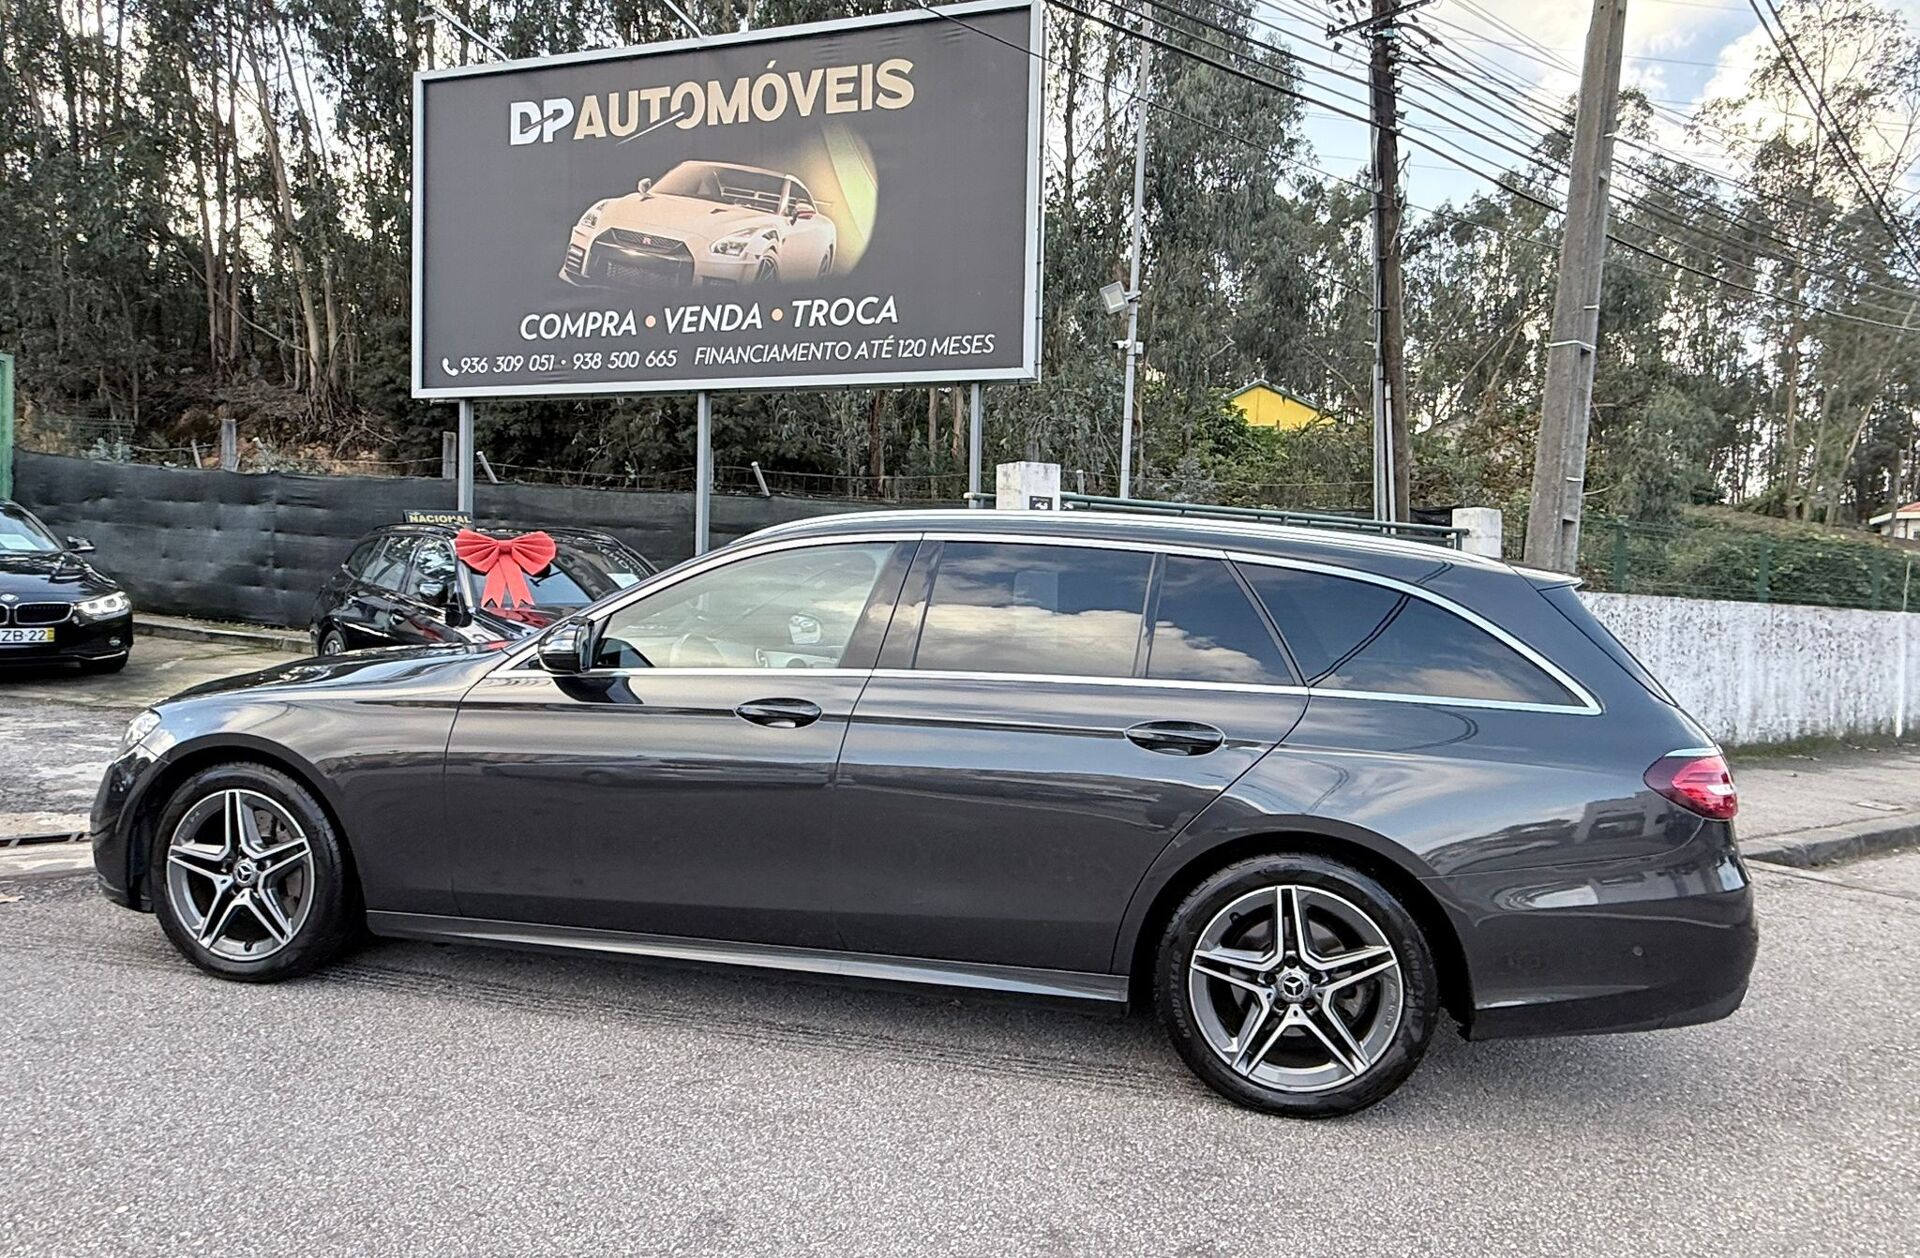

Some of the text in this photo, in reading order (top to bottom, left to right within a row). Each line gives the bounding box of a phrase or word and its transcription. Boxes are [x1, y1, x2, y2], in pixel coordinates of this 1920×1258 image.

[519, 295, 898, 340] COMPRA VENDA TROCA
[459, 350, 678, 374] 936 309 051 938 500 665
[694, 334, 996, 365] FINANCIAMENTO ATÉ 120 MESES
